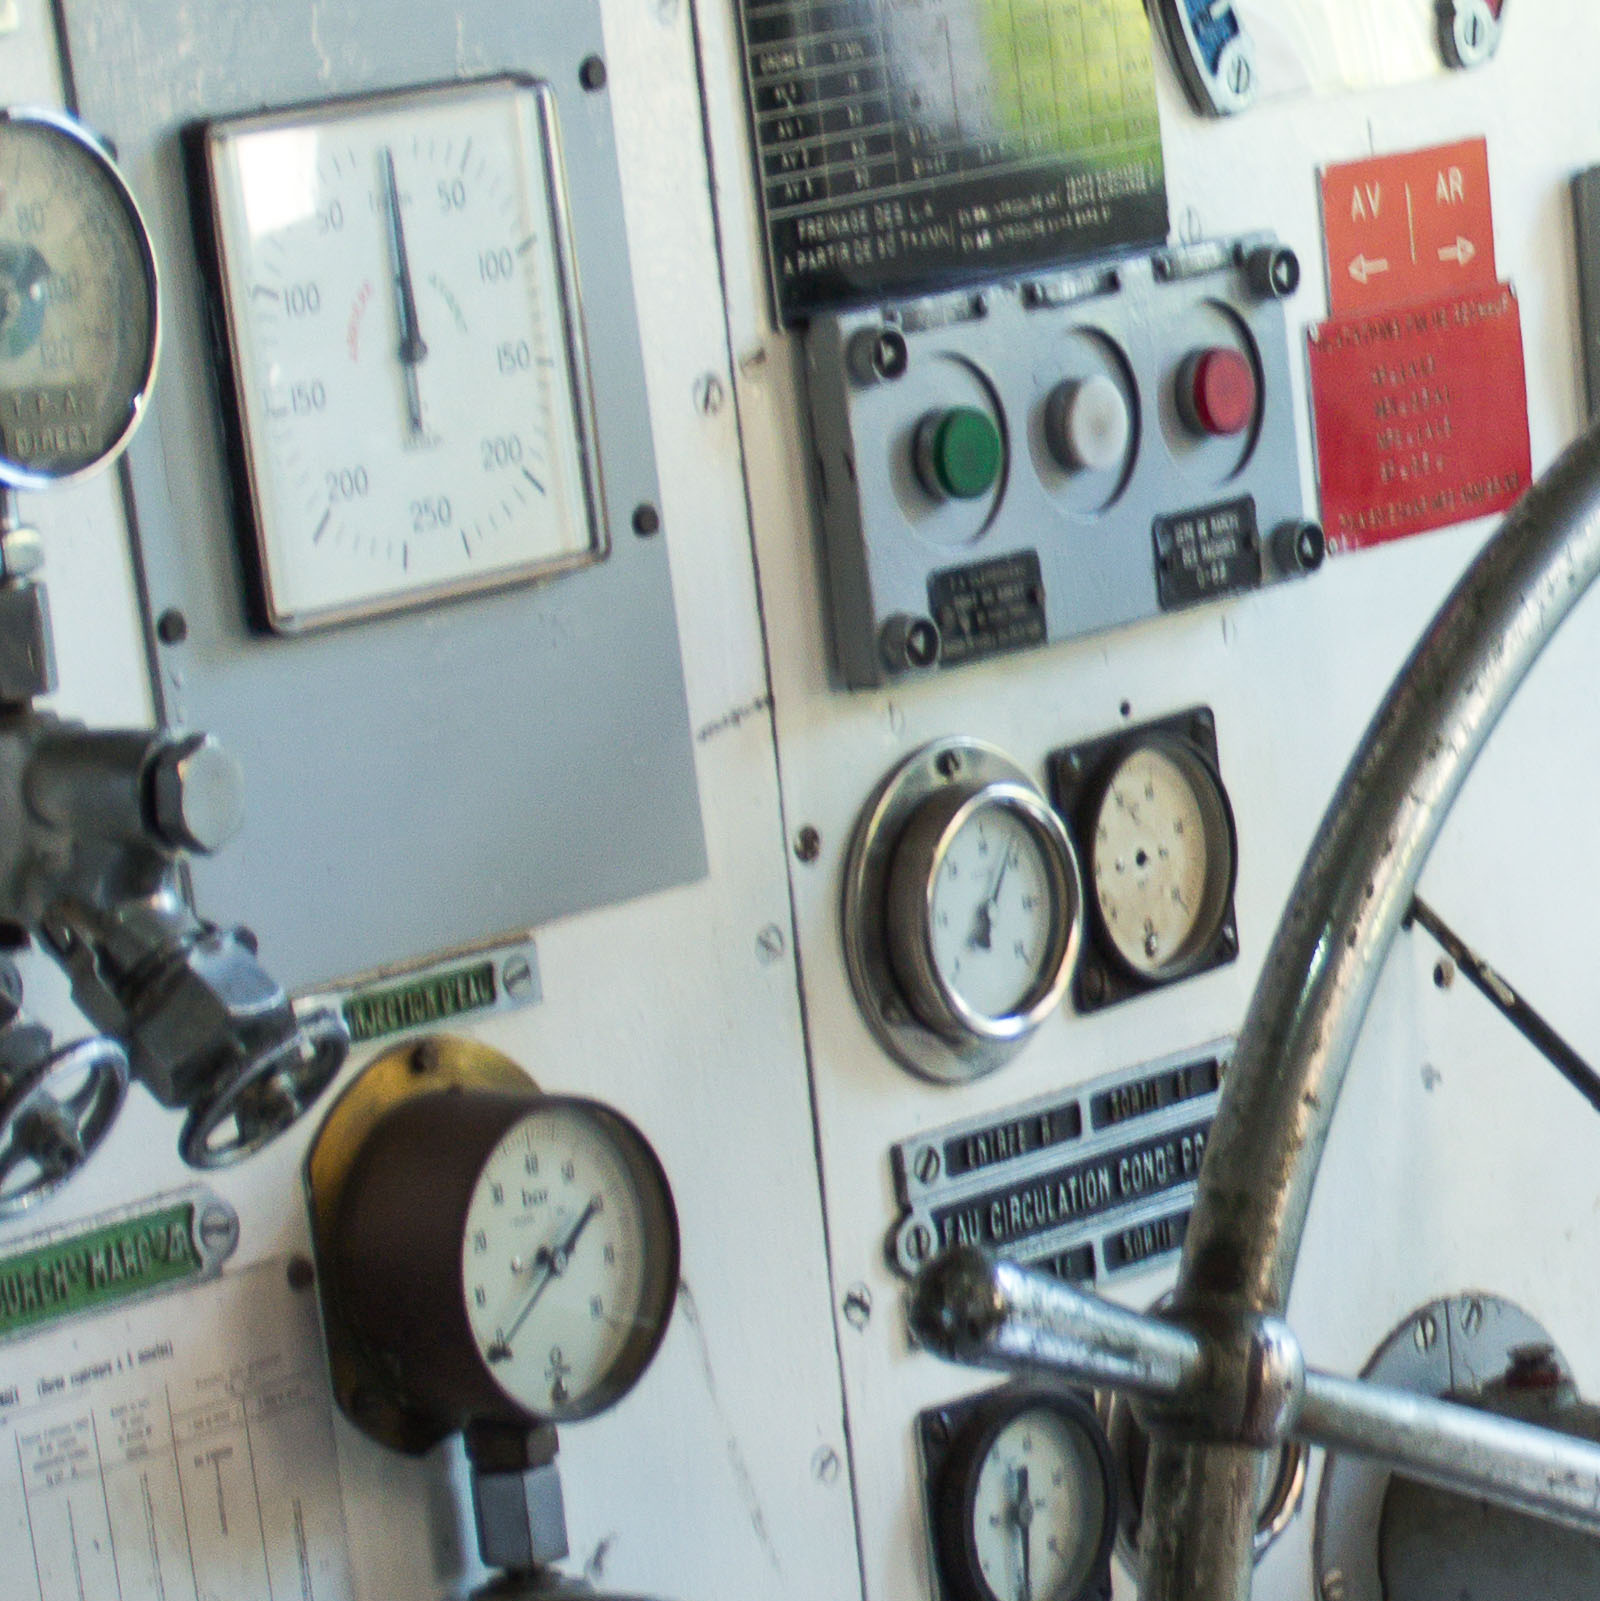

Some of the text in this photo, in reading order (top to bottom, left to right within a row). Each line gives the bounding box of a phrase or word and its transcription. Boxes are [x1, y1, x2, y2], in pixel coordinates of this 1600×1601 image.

[437, 180, 467, 212] 50
[1350, 181, 1381, 223] AV
[1436, 165, 1466, 205] AR
[478, 248, 514, 282] 100
[283, 281, 321, 317] 100
[496, 339, 531, 373] 150
[290, 378, 327, 414] 150
[480, 433, 523, 472] 200
[325, 465, 369, 503] 200
[409, 494, 452, 534] 250
[521, 1187, 549, 1208] bar
[990, 1167, 1111, 1241] CIRCULATION
